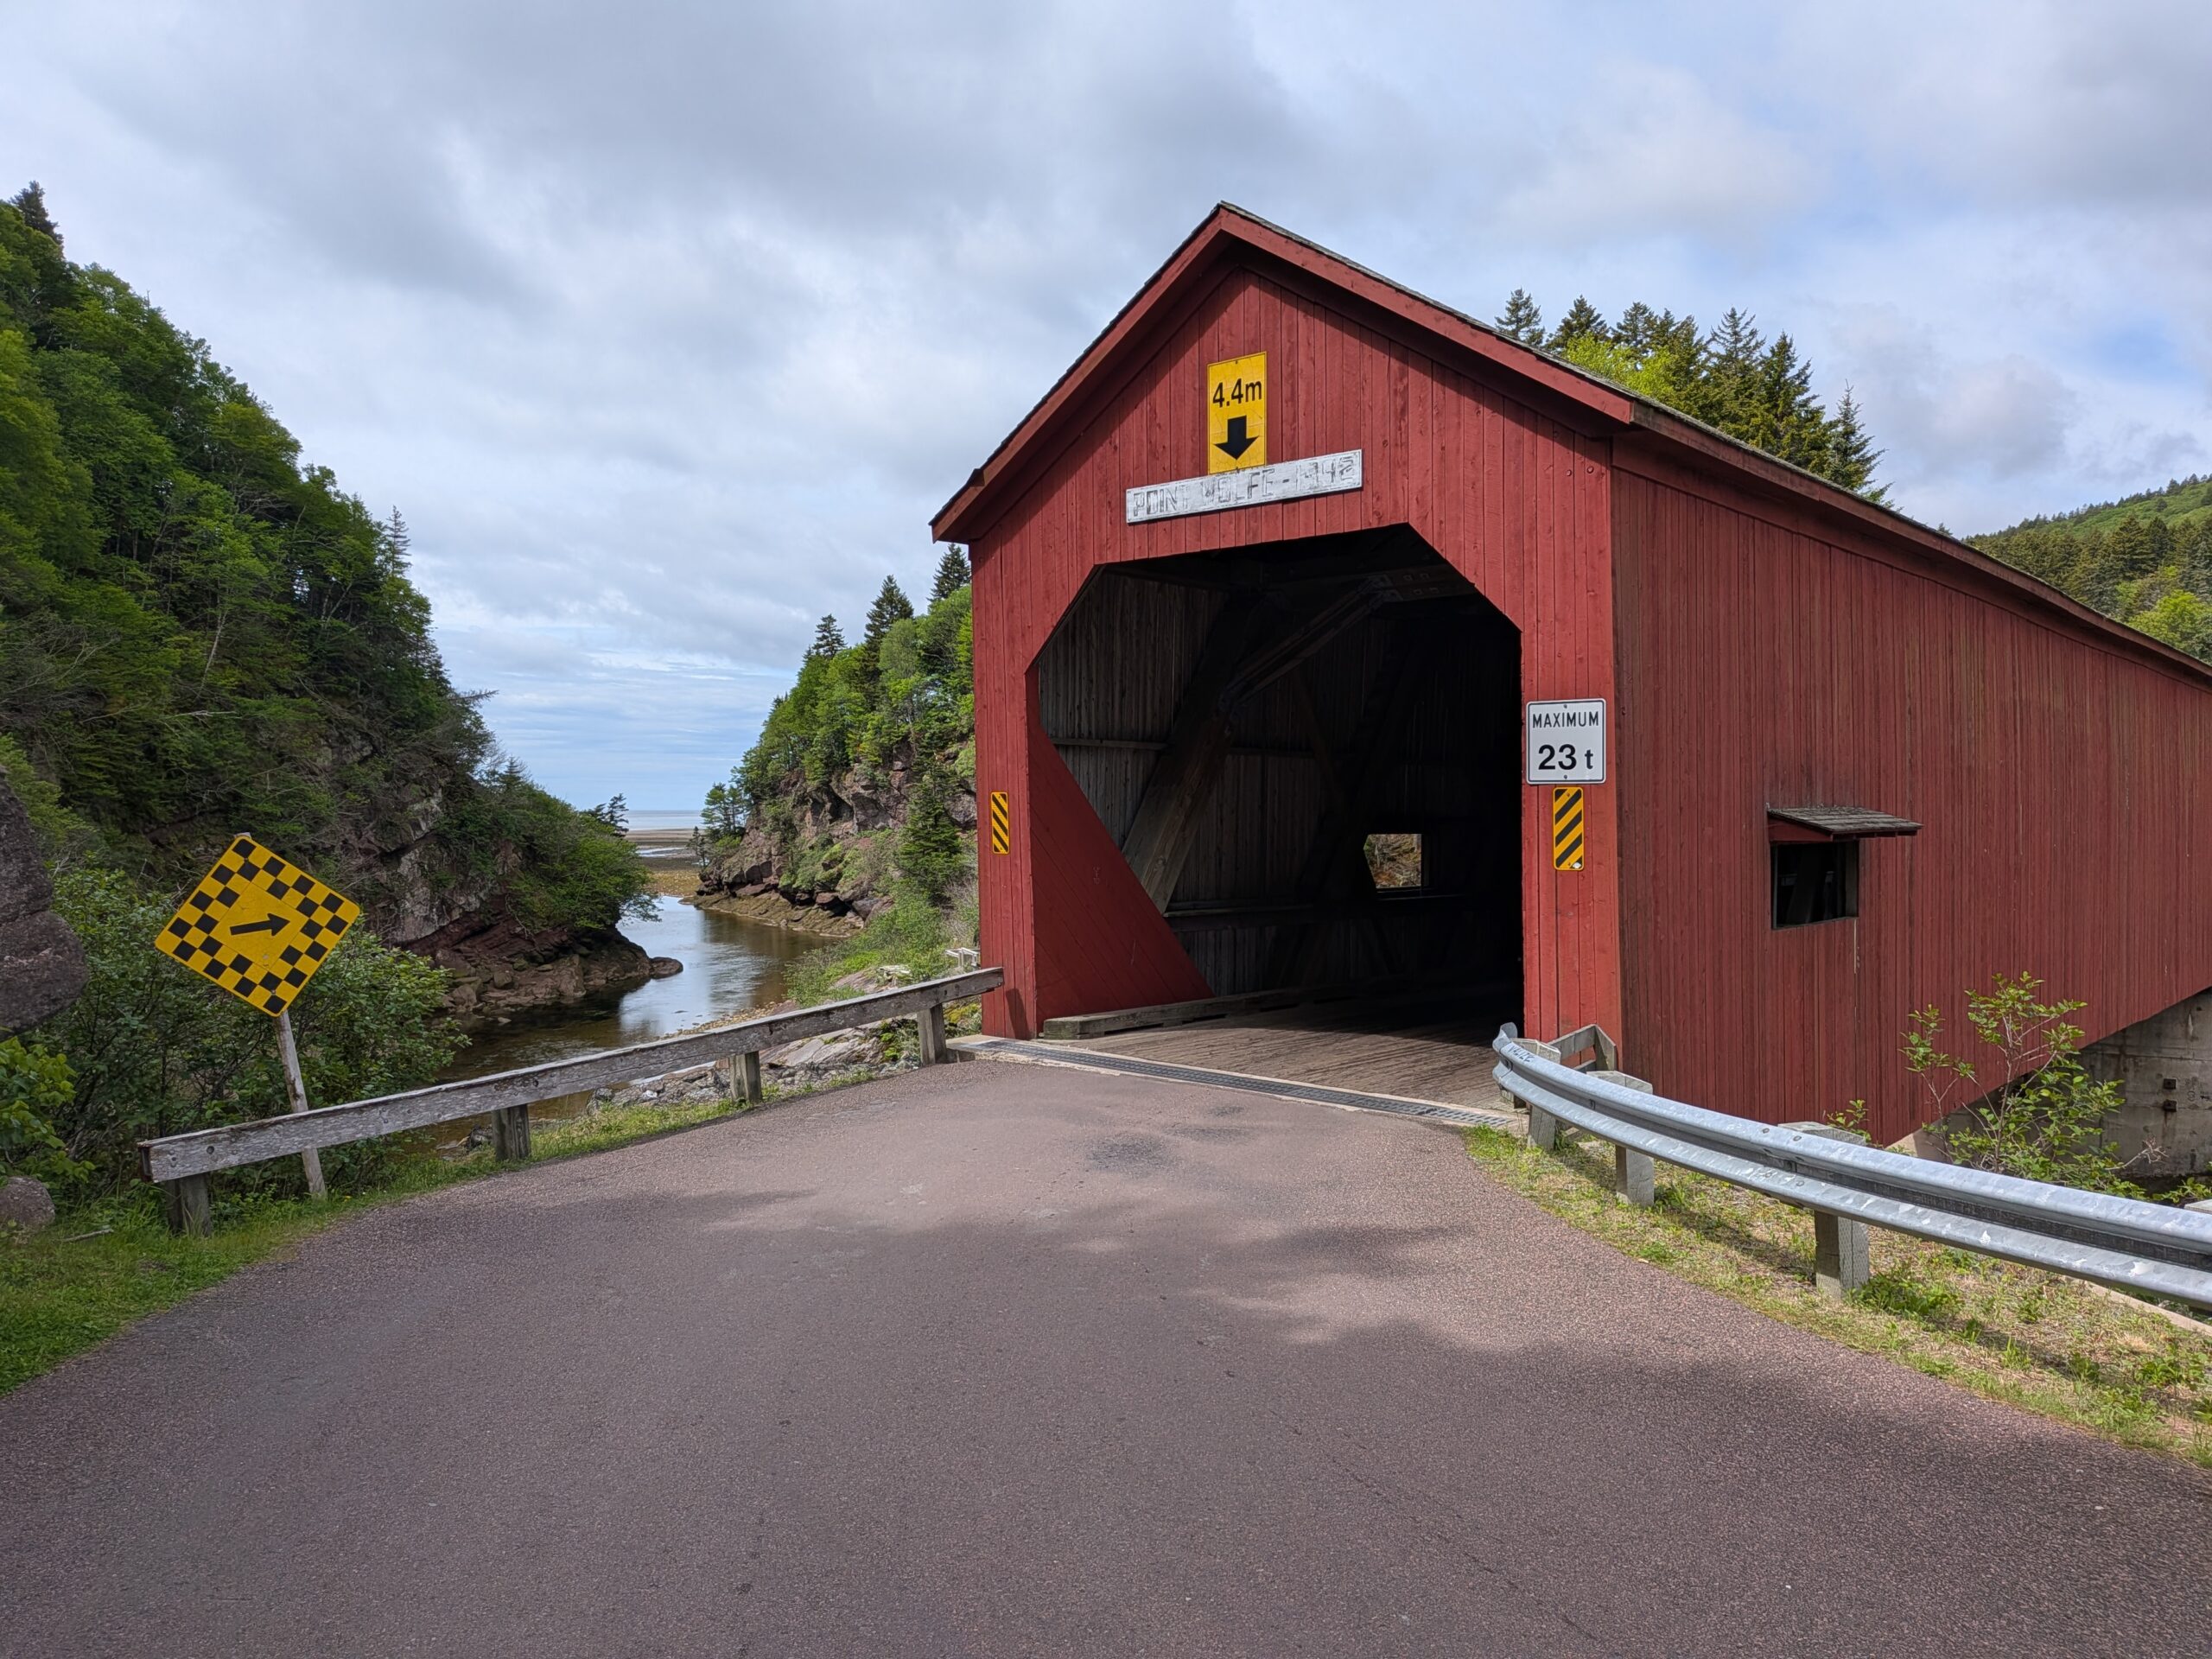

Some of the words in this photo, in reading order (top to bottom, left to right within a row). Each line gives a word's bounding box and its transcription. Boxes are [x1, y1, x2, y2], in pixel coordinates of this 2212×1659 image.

[1212, 378, 1262, 408] 4.4m
[1133, 484, 1192, 517] POINT
[1532, 711, 1599, 728] MAXIMUM
[1538, 744, 1577, 770] 23
[1585, 749, 1594, 770] t
